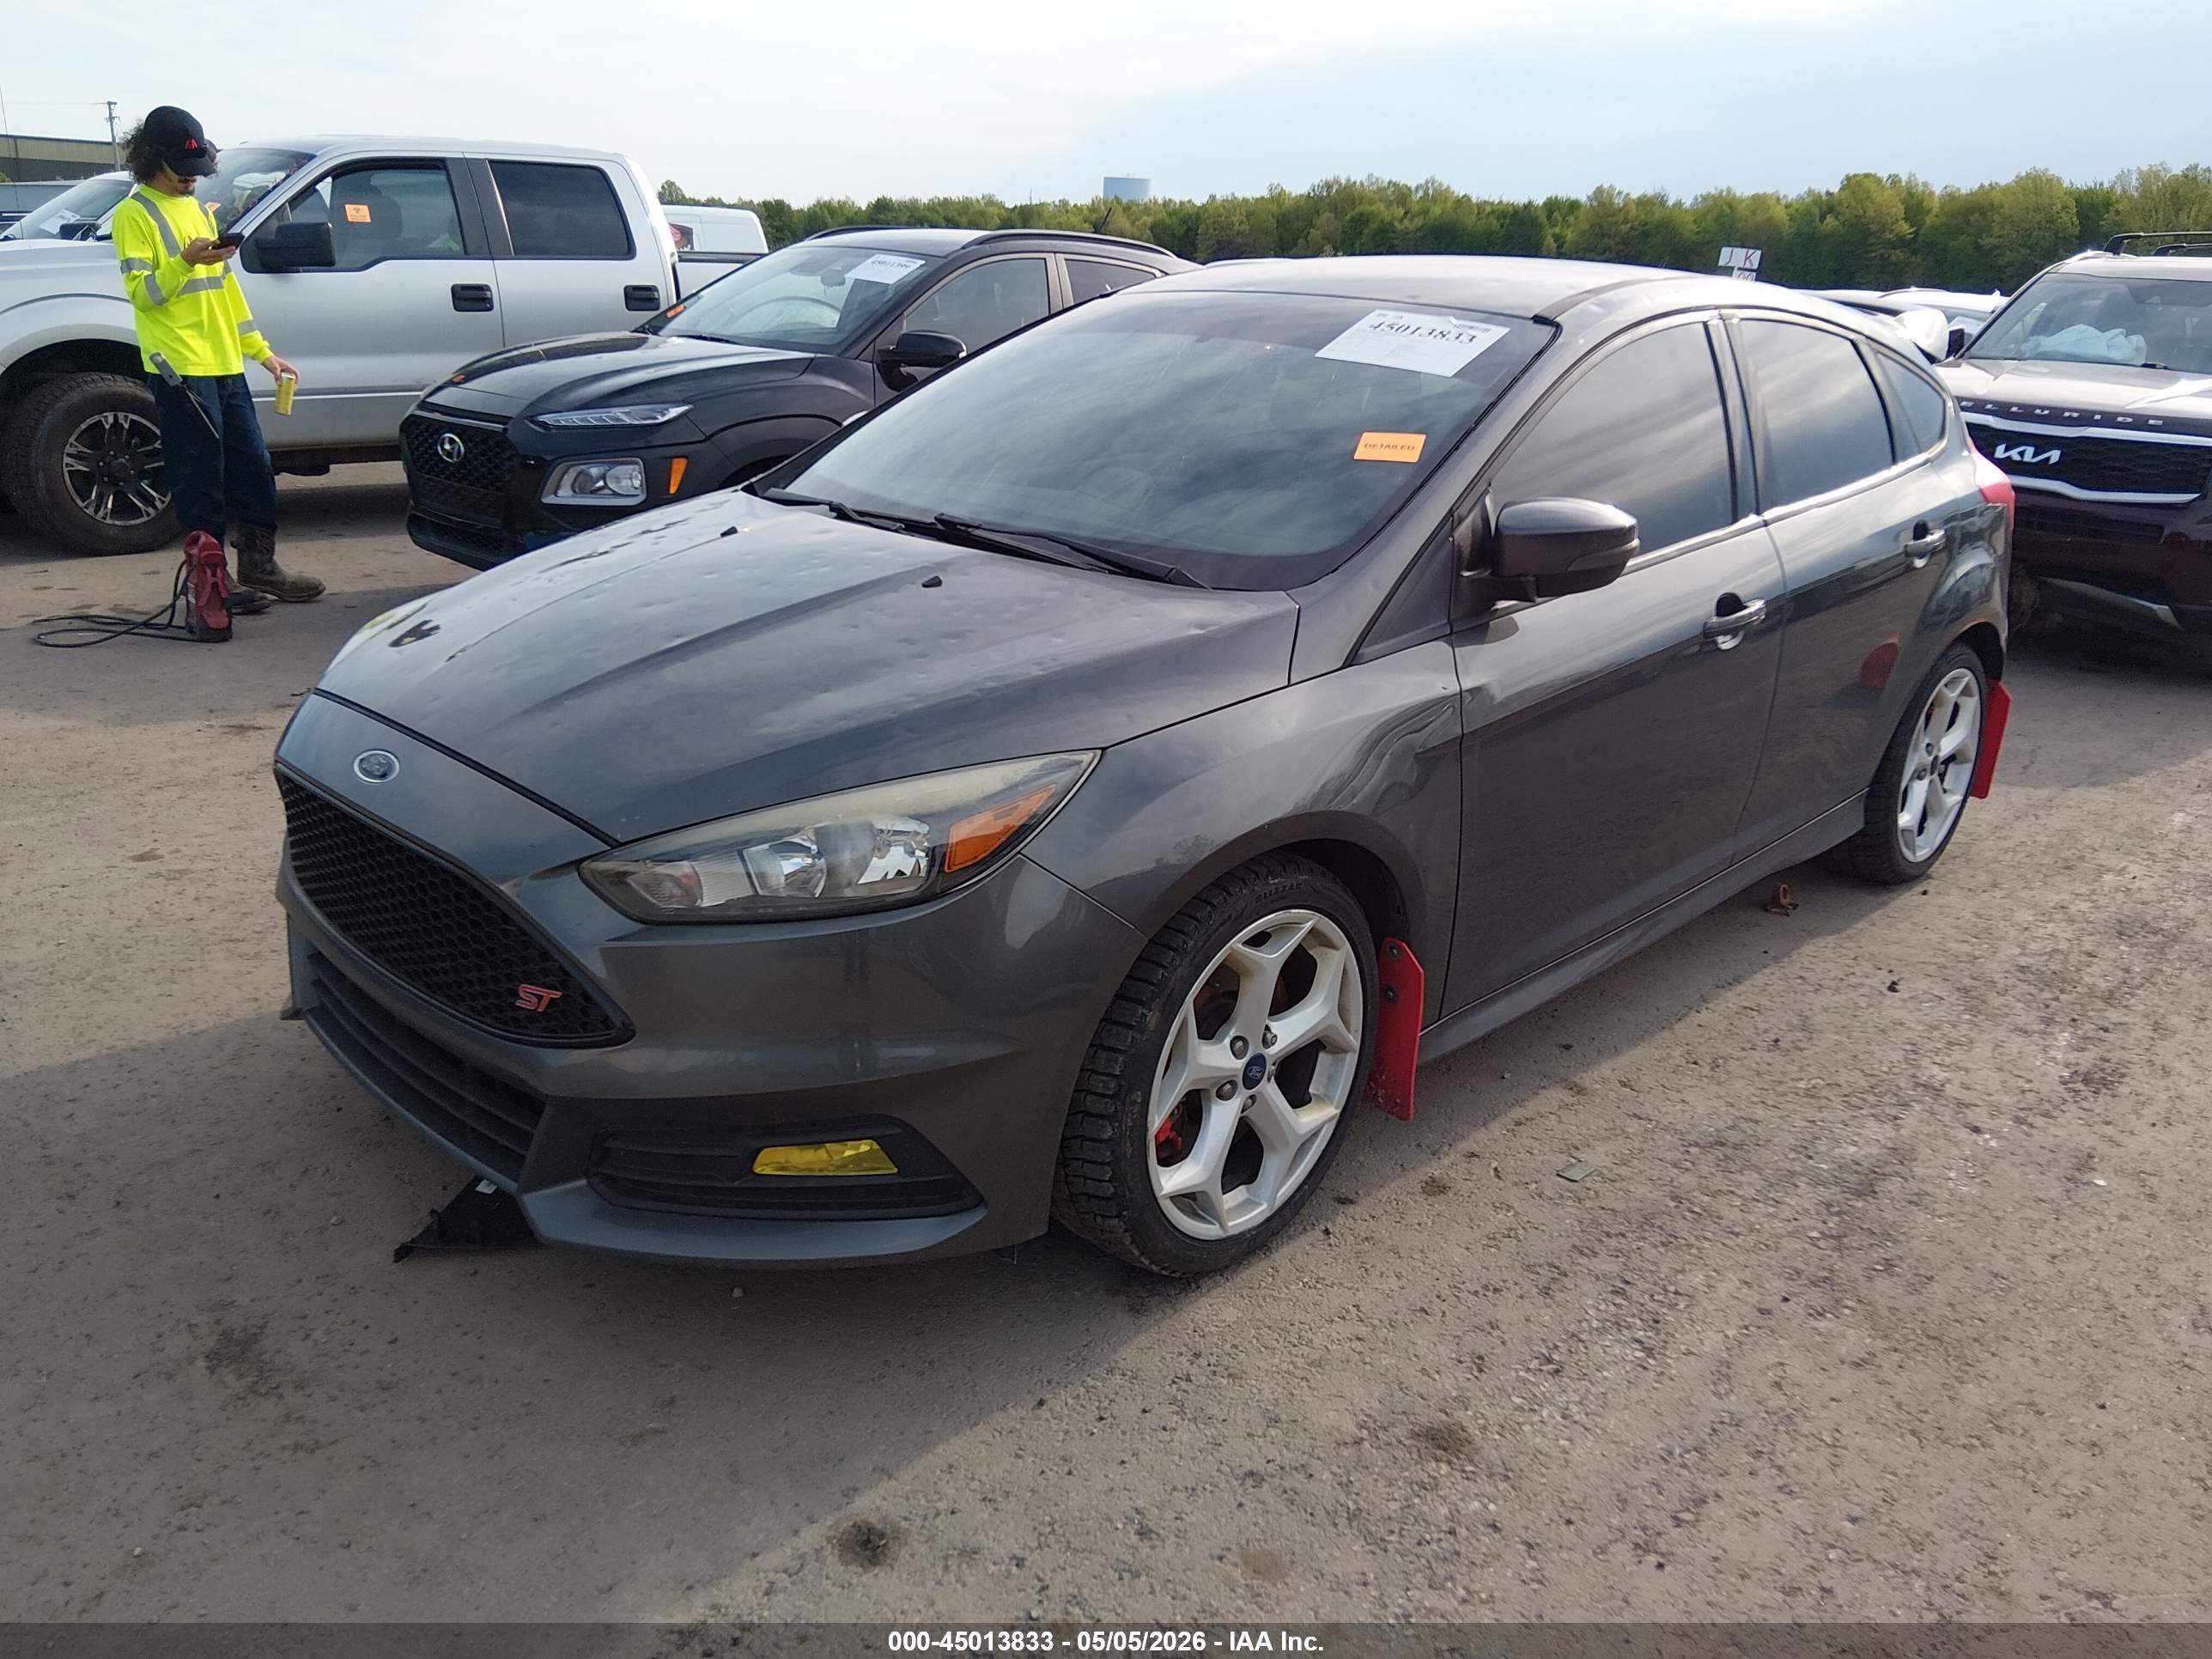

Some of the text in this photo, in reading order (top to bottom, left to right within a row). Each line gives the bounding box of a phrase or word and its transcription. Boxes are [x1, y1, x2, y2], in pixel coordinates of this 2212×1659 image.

[1743, 249, 1758, 268] K
[1369, 320, 1478, 344] 45013833
[1960, 400, 2164, 426] ELLURIDE
[1363, 442, 1416, 453] DETAILED
[1994, 443, 2062, 465] KIA
[514, 983, 564, 1012] ST
